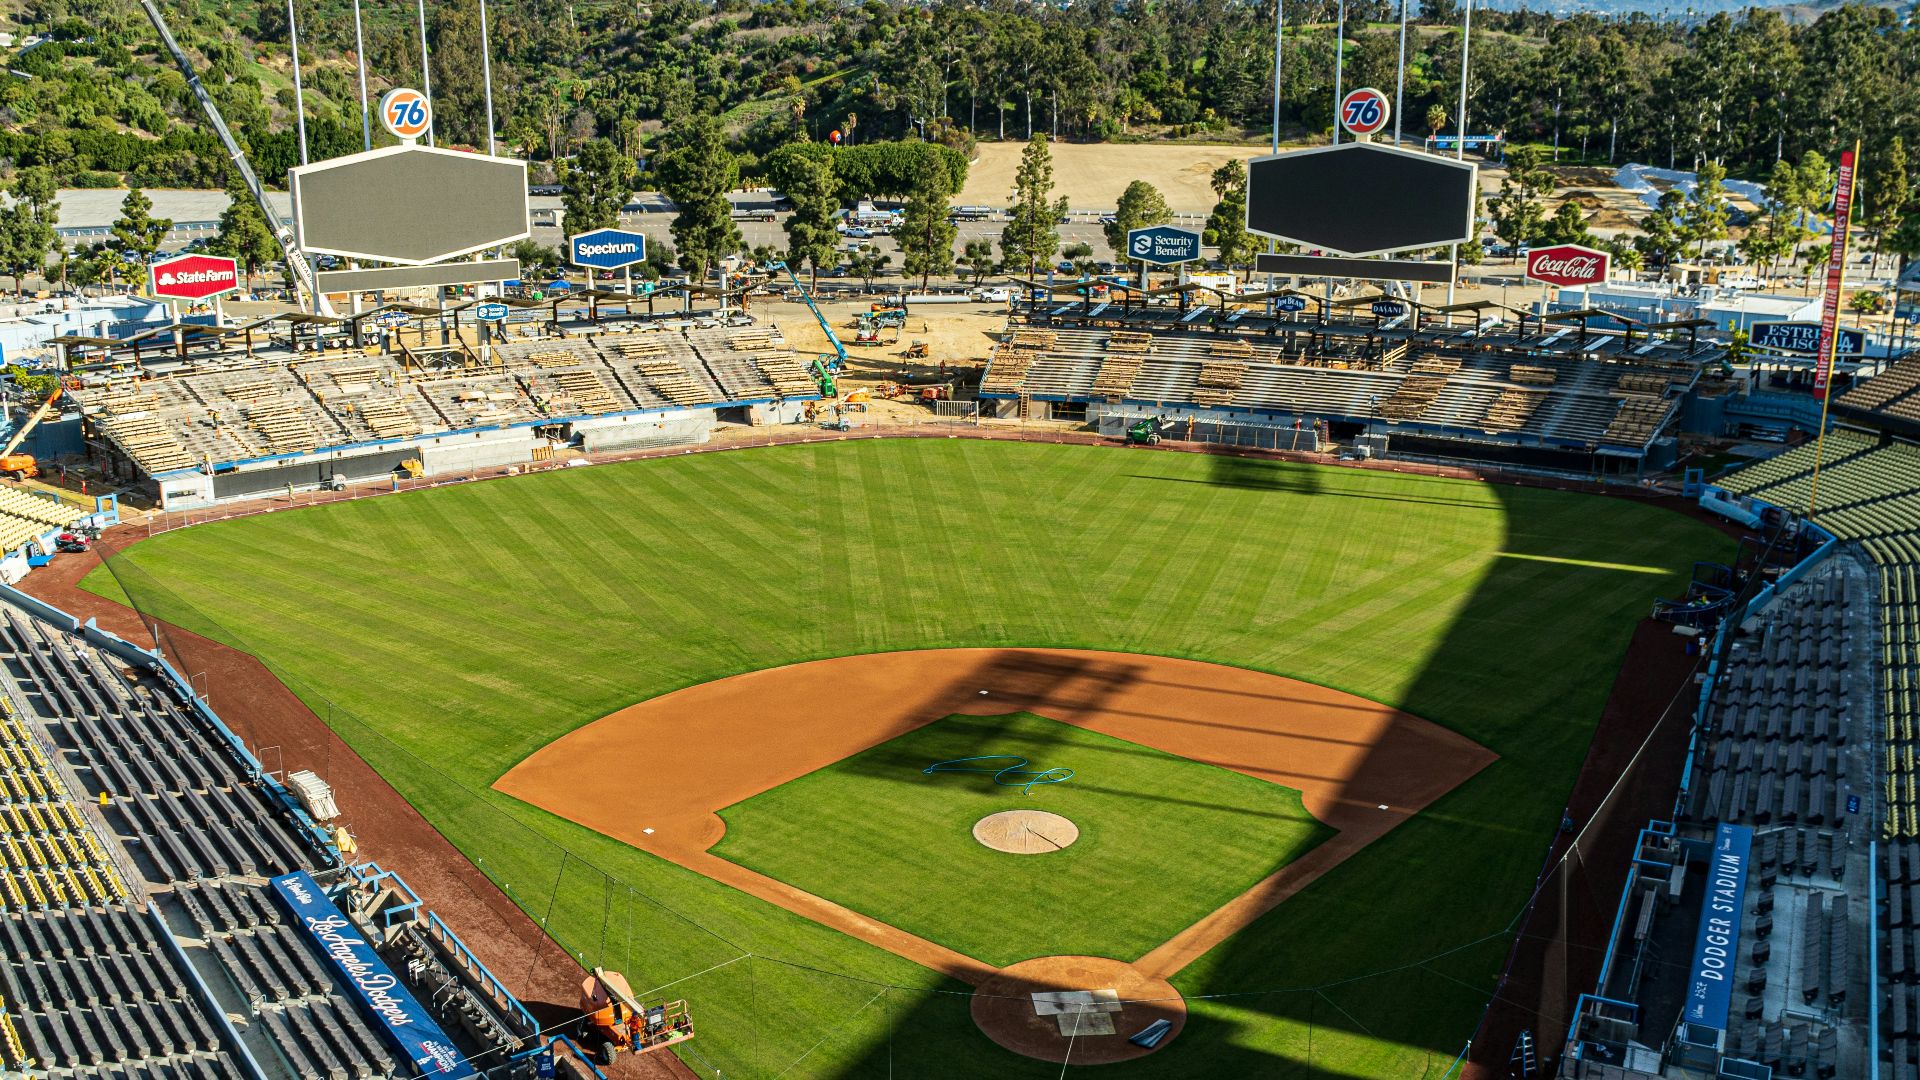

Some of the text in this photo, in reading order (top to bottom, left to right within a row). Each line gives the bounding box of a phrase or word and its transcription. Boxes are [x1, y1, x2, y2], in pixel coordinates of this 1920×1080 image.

[392, 99, 426, 127] 76
[1346, 98, 1380, 126] 76
[1830, 166, 1852, 269] Emirates FLY BETTER
[579, 242, 635, 257] Spectrum
[1155, 235, 1193, 248] Security
[1155, 246, 1187, 256] Benefit
[1532, 254, 1600, 279] Coca-Cola
[1276, 298, 1287, 308] JIM
[1287, 297, 1303, 309] BEAM
[1373, 305, 1402, 314] DASANI
[1760, 335, 1819, 350] JALISC
[1815, 289, 1838, 389] Emirates FLY BETTER
[1712, 854, 1740, 912] STADIUM
[1701, 918, 1731, 980] DODGER
[307, 915, 413, 1025] Los Angeles Dodgers
